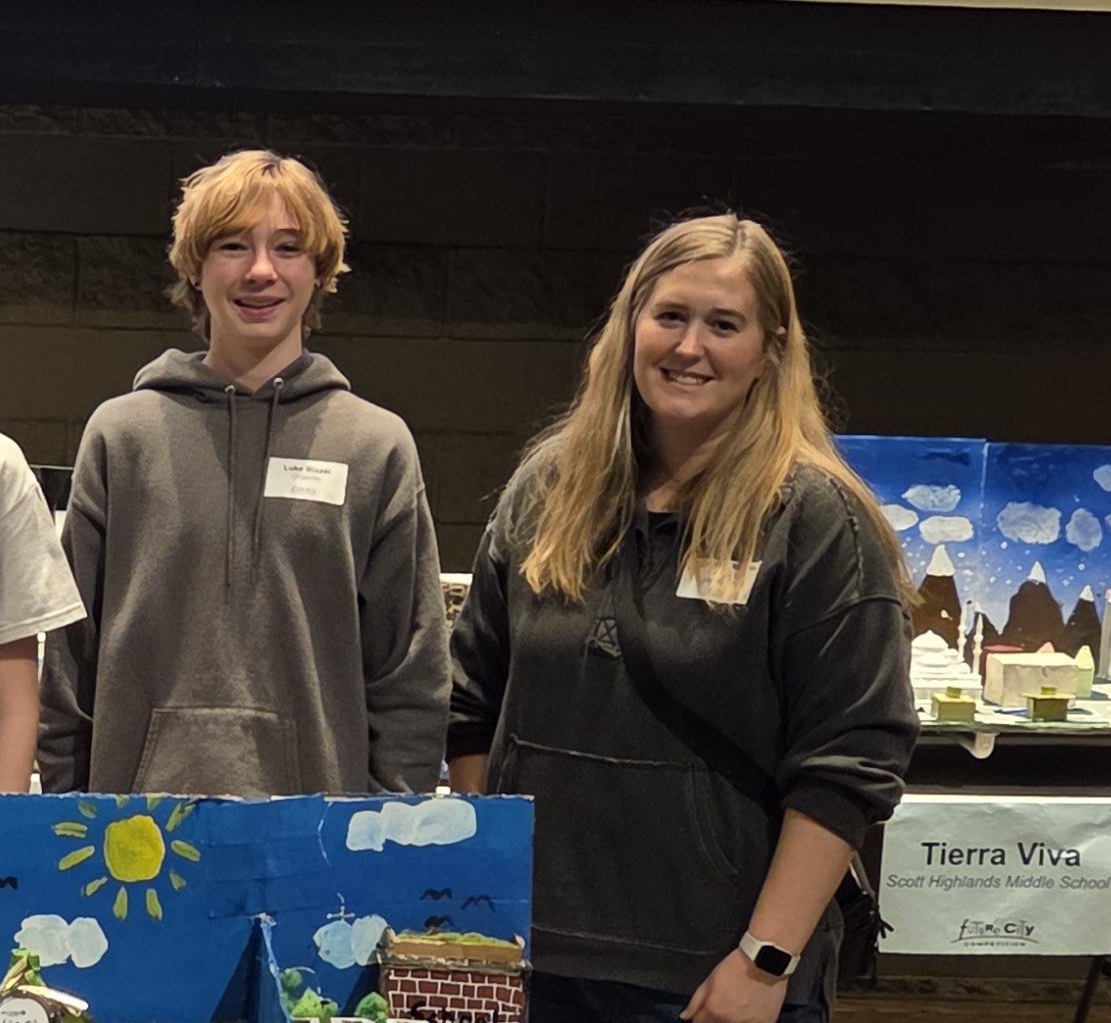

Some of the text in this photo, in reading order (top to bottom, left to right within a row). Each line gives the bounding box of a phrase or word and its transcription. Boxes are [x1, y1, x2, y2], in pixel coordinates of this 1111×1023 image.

[921, 842, 1081, 867] Tierra Viva
[886, 874, 1111, 891] Scott Highlands Middle School
